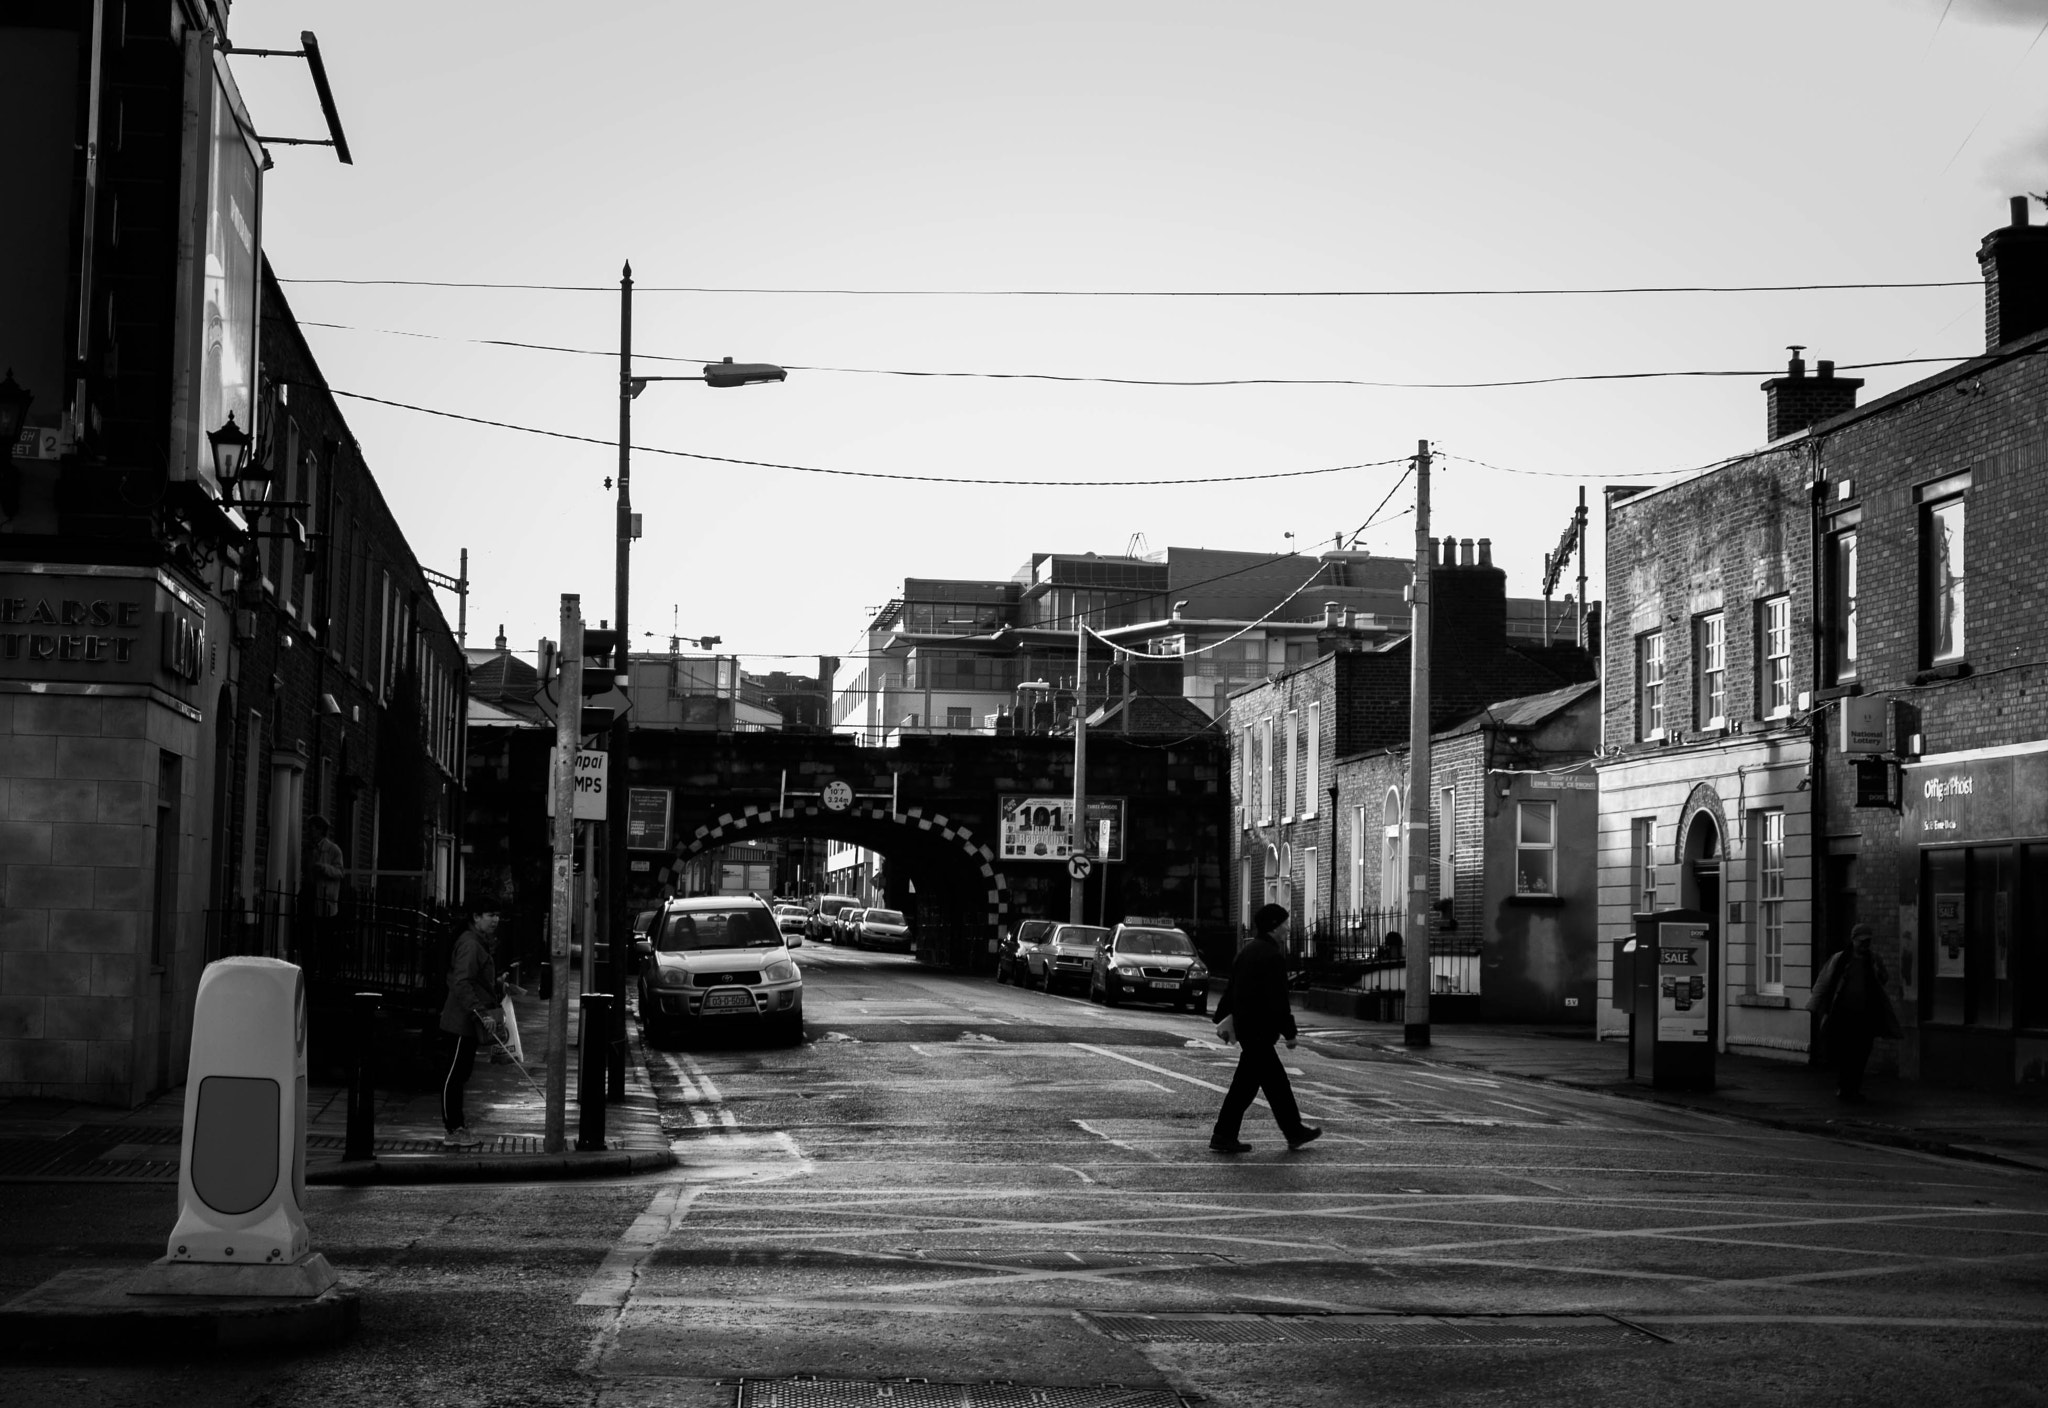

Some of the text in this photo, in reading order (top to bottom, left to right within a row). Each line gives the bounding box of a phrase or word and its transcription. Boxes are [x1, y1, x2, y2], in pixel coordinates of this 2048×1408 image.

[45, 436, 57, 452] 2
[0, 598, 140, 628] EARSE
[0, 633, 138, 663] TREET
[1850, 730, 1883, 738] National
[1853, 737, 1881, 746] Lottery
[574, 775, 602, 794] MPS
[1019, 806, 1066, 832] 101
[1664, 952, 1689, 964] SALE
